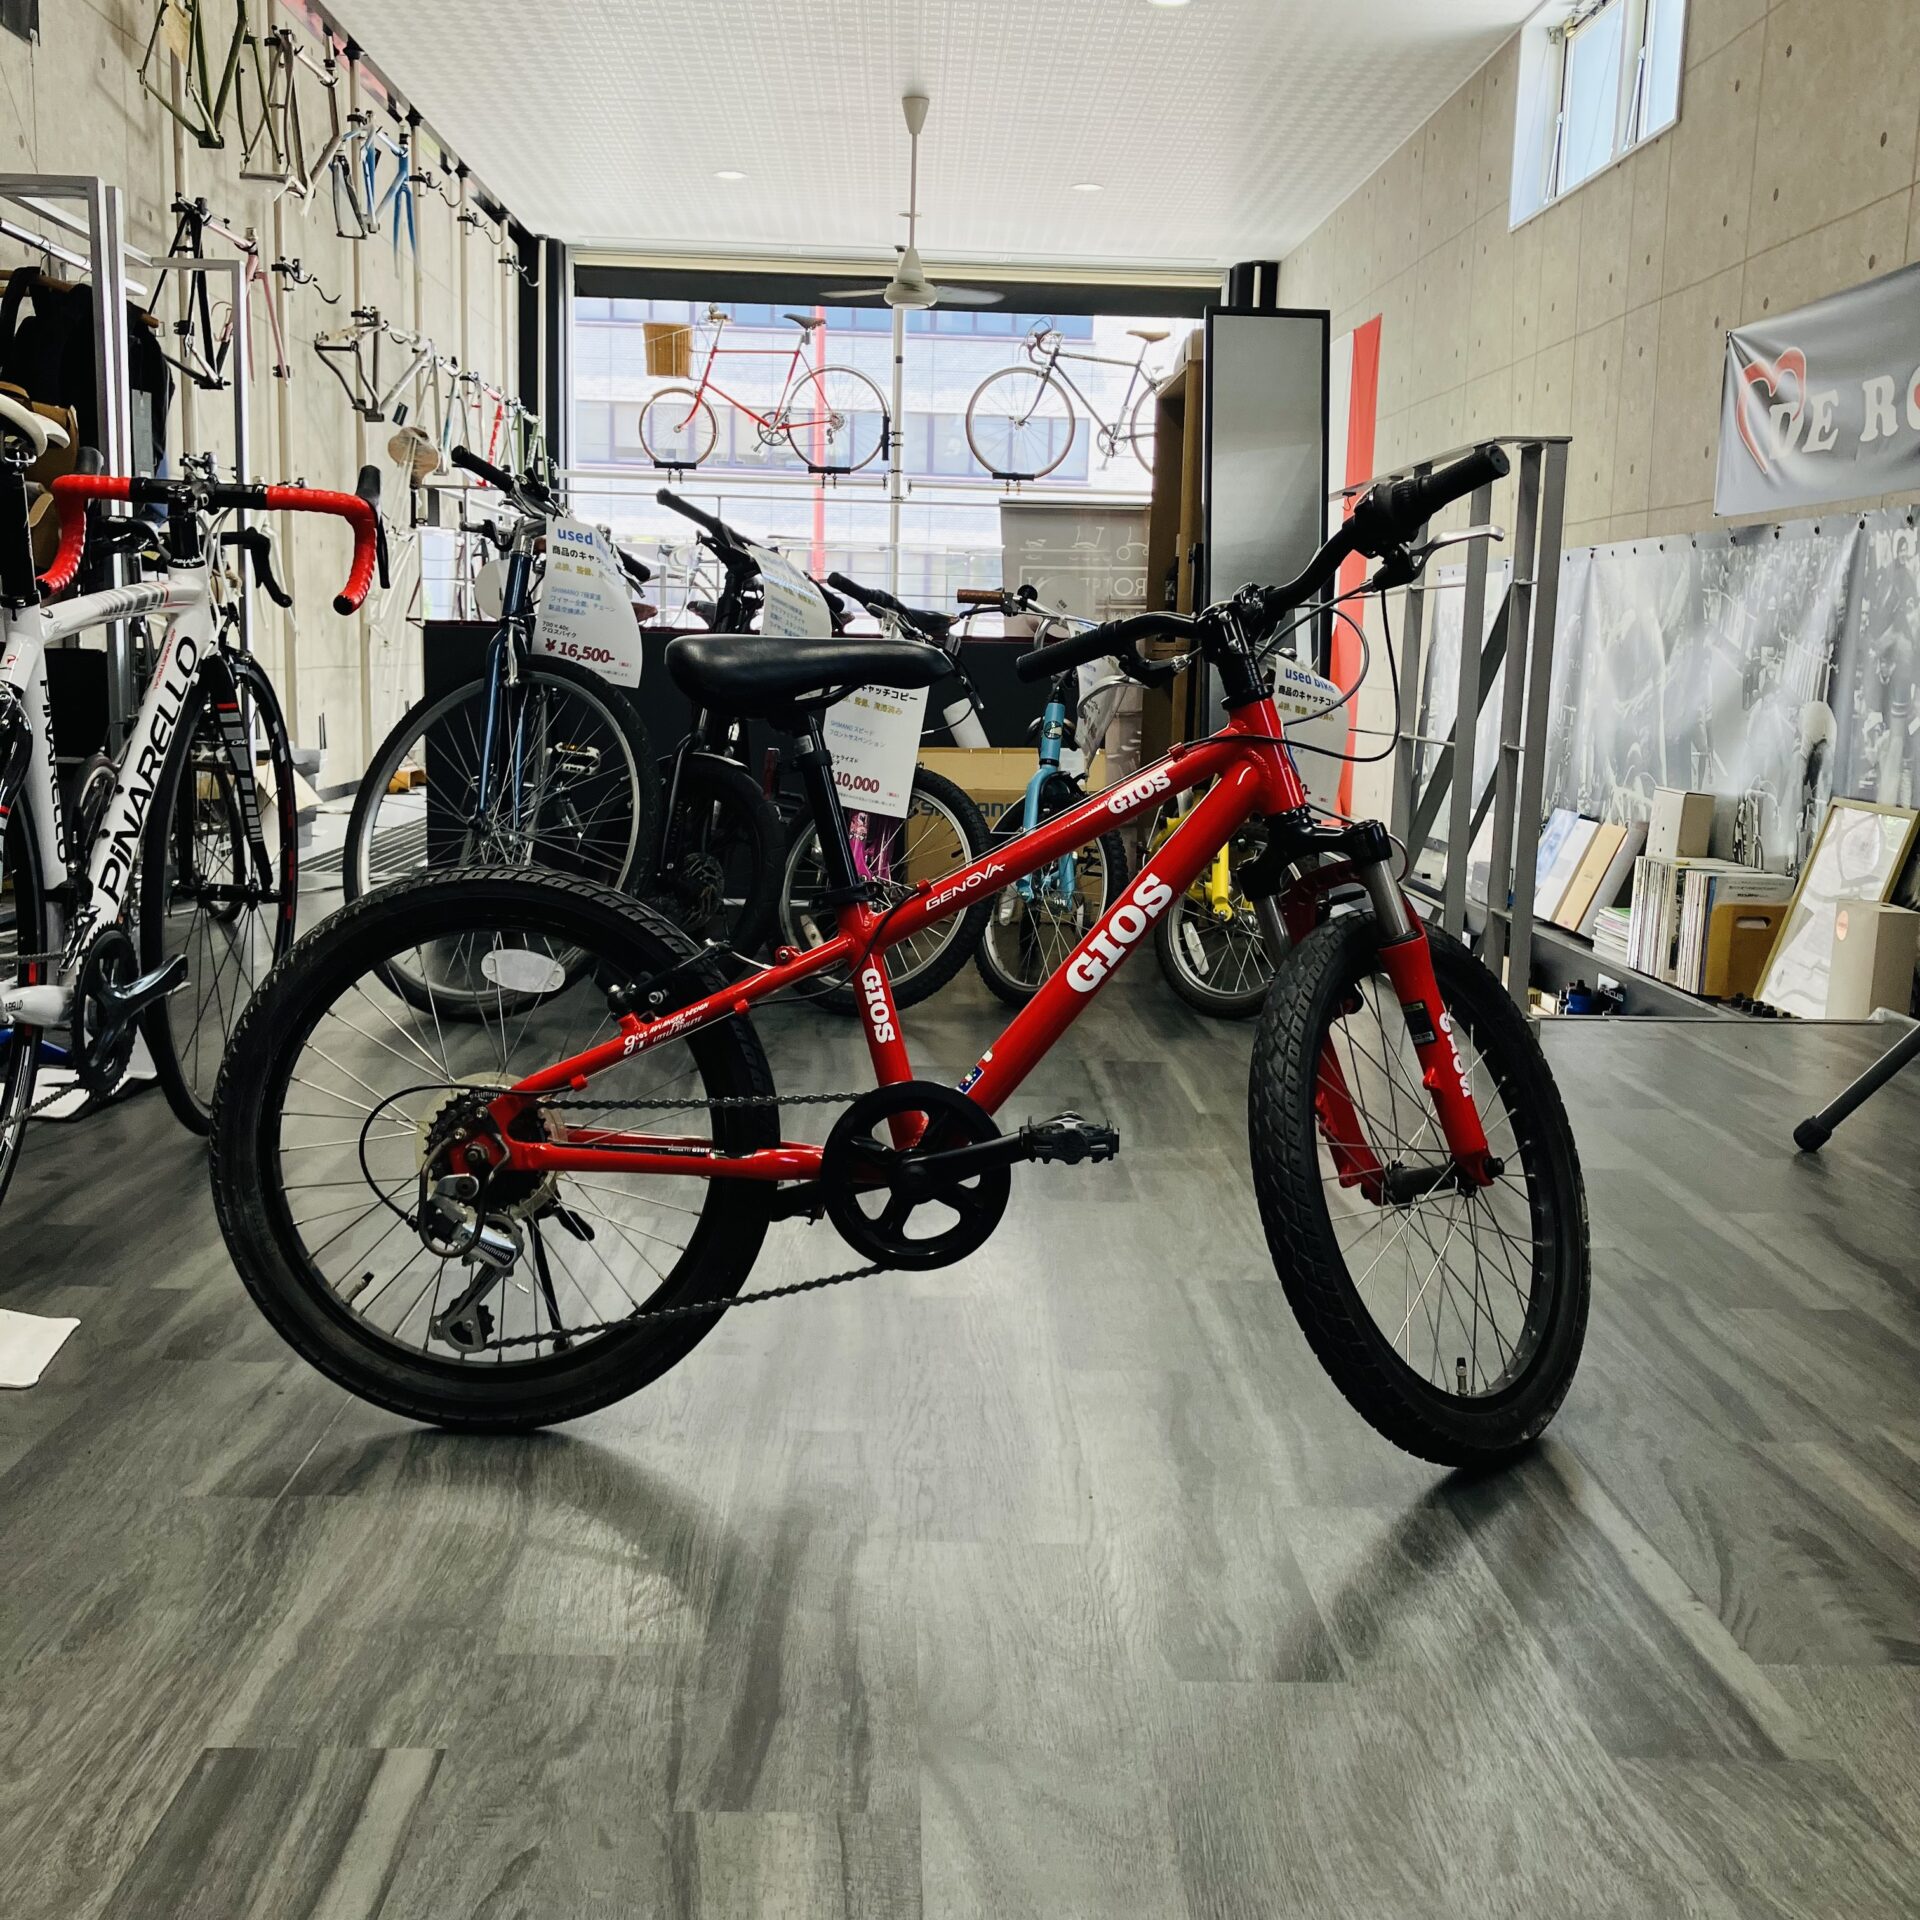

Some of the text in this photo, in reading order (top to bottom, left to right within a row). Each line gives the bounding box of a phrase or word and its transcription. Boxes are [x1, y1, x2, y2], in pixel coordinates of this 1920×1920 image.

[1769, 389, 1839, 460] DE
[557, 528, 593, 545] used
[542, 626, 577, 638] クロスバイク
[1285, 667, 1312, 685] used
[98, 635, 199, 905] PINARELLO
[832, 770, 880, 794] 10,000
[1106, 770, 1172, 814] GIOS
[926, 863, 1005, 911] GENOVA
[1066, 873, 1173, 993] GIOS
[684, 1001, 710, 1018] DESIGN
[861, 967, 896, 1044] GIOS
[1439, 1012, 1472, 1098] GIOS
